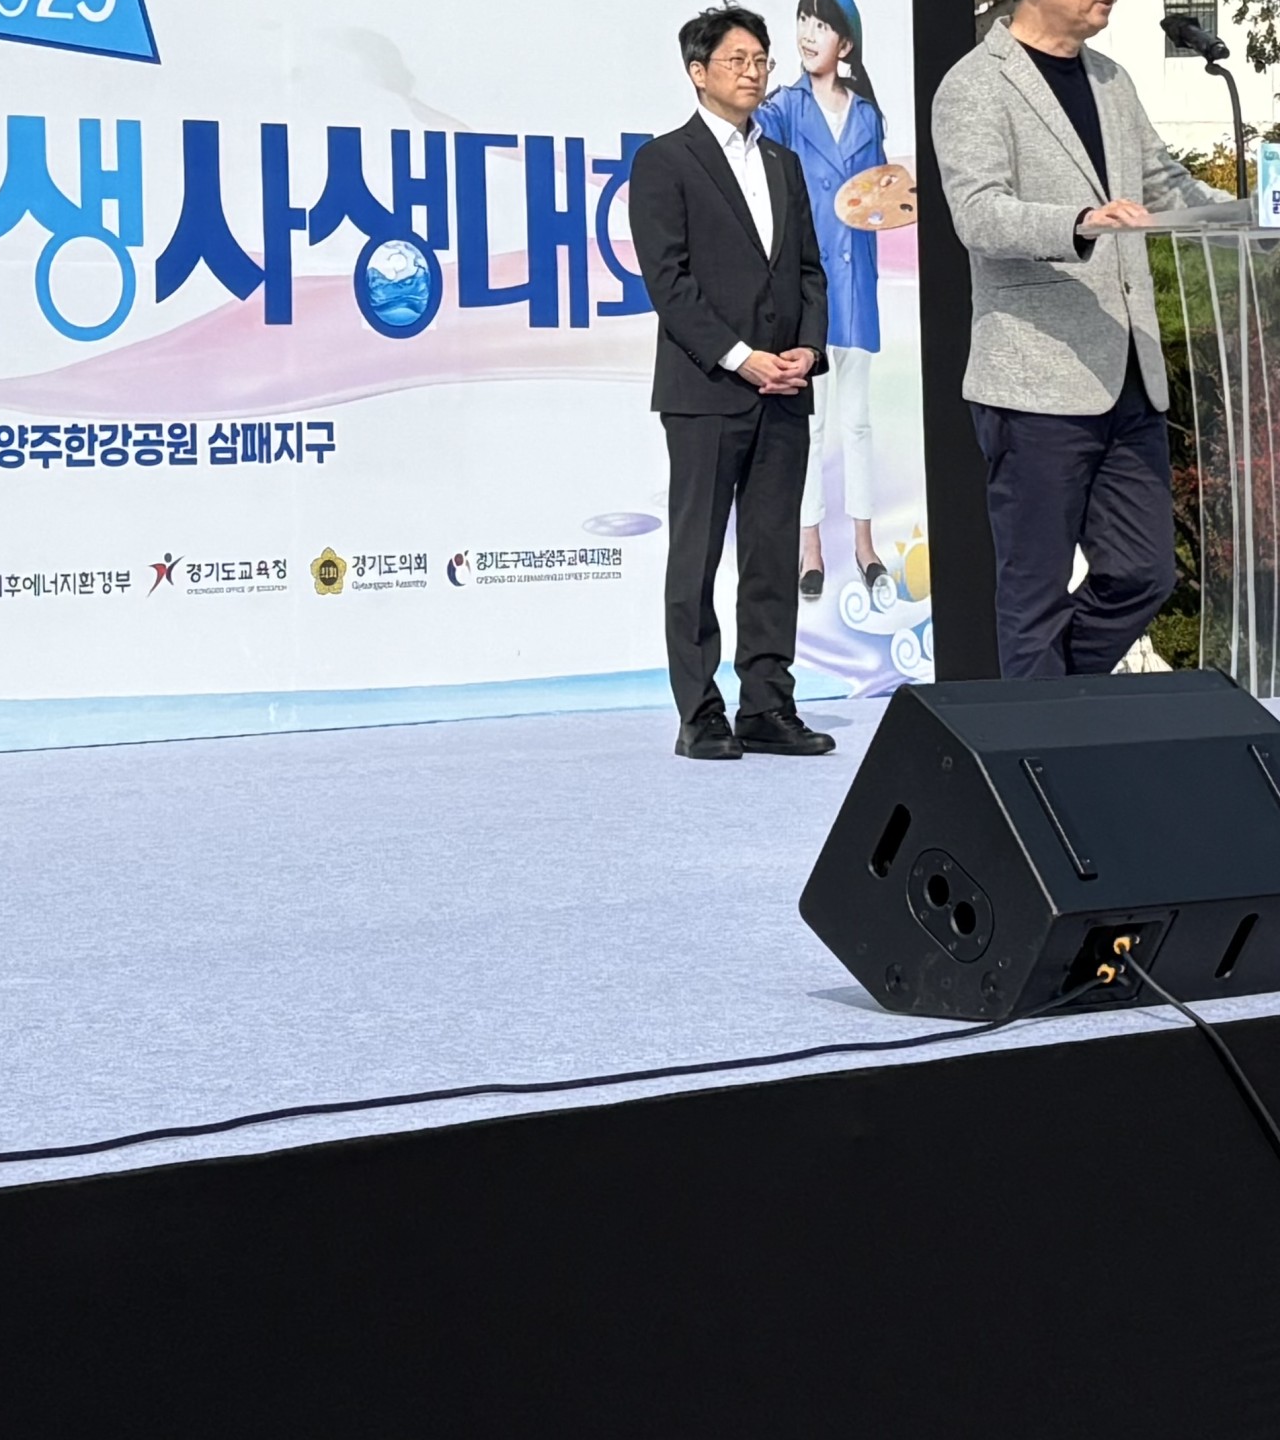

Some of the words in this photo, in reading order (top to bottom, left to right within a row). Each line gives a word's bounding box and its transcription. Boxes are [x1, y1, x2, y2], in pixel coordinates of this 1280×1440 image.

[208, 421, 336, 465] 삼패지구
[186, 558, 287, 584] 경기도교육청
[352, 553, 427, 577] 경기도의회
